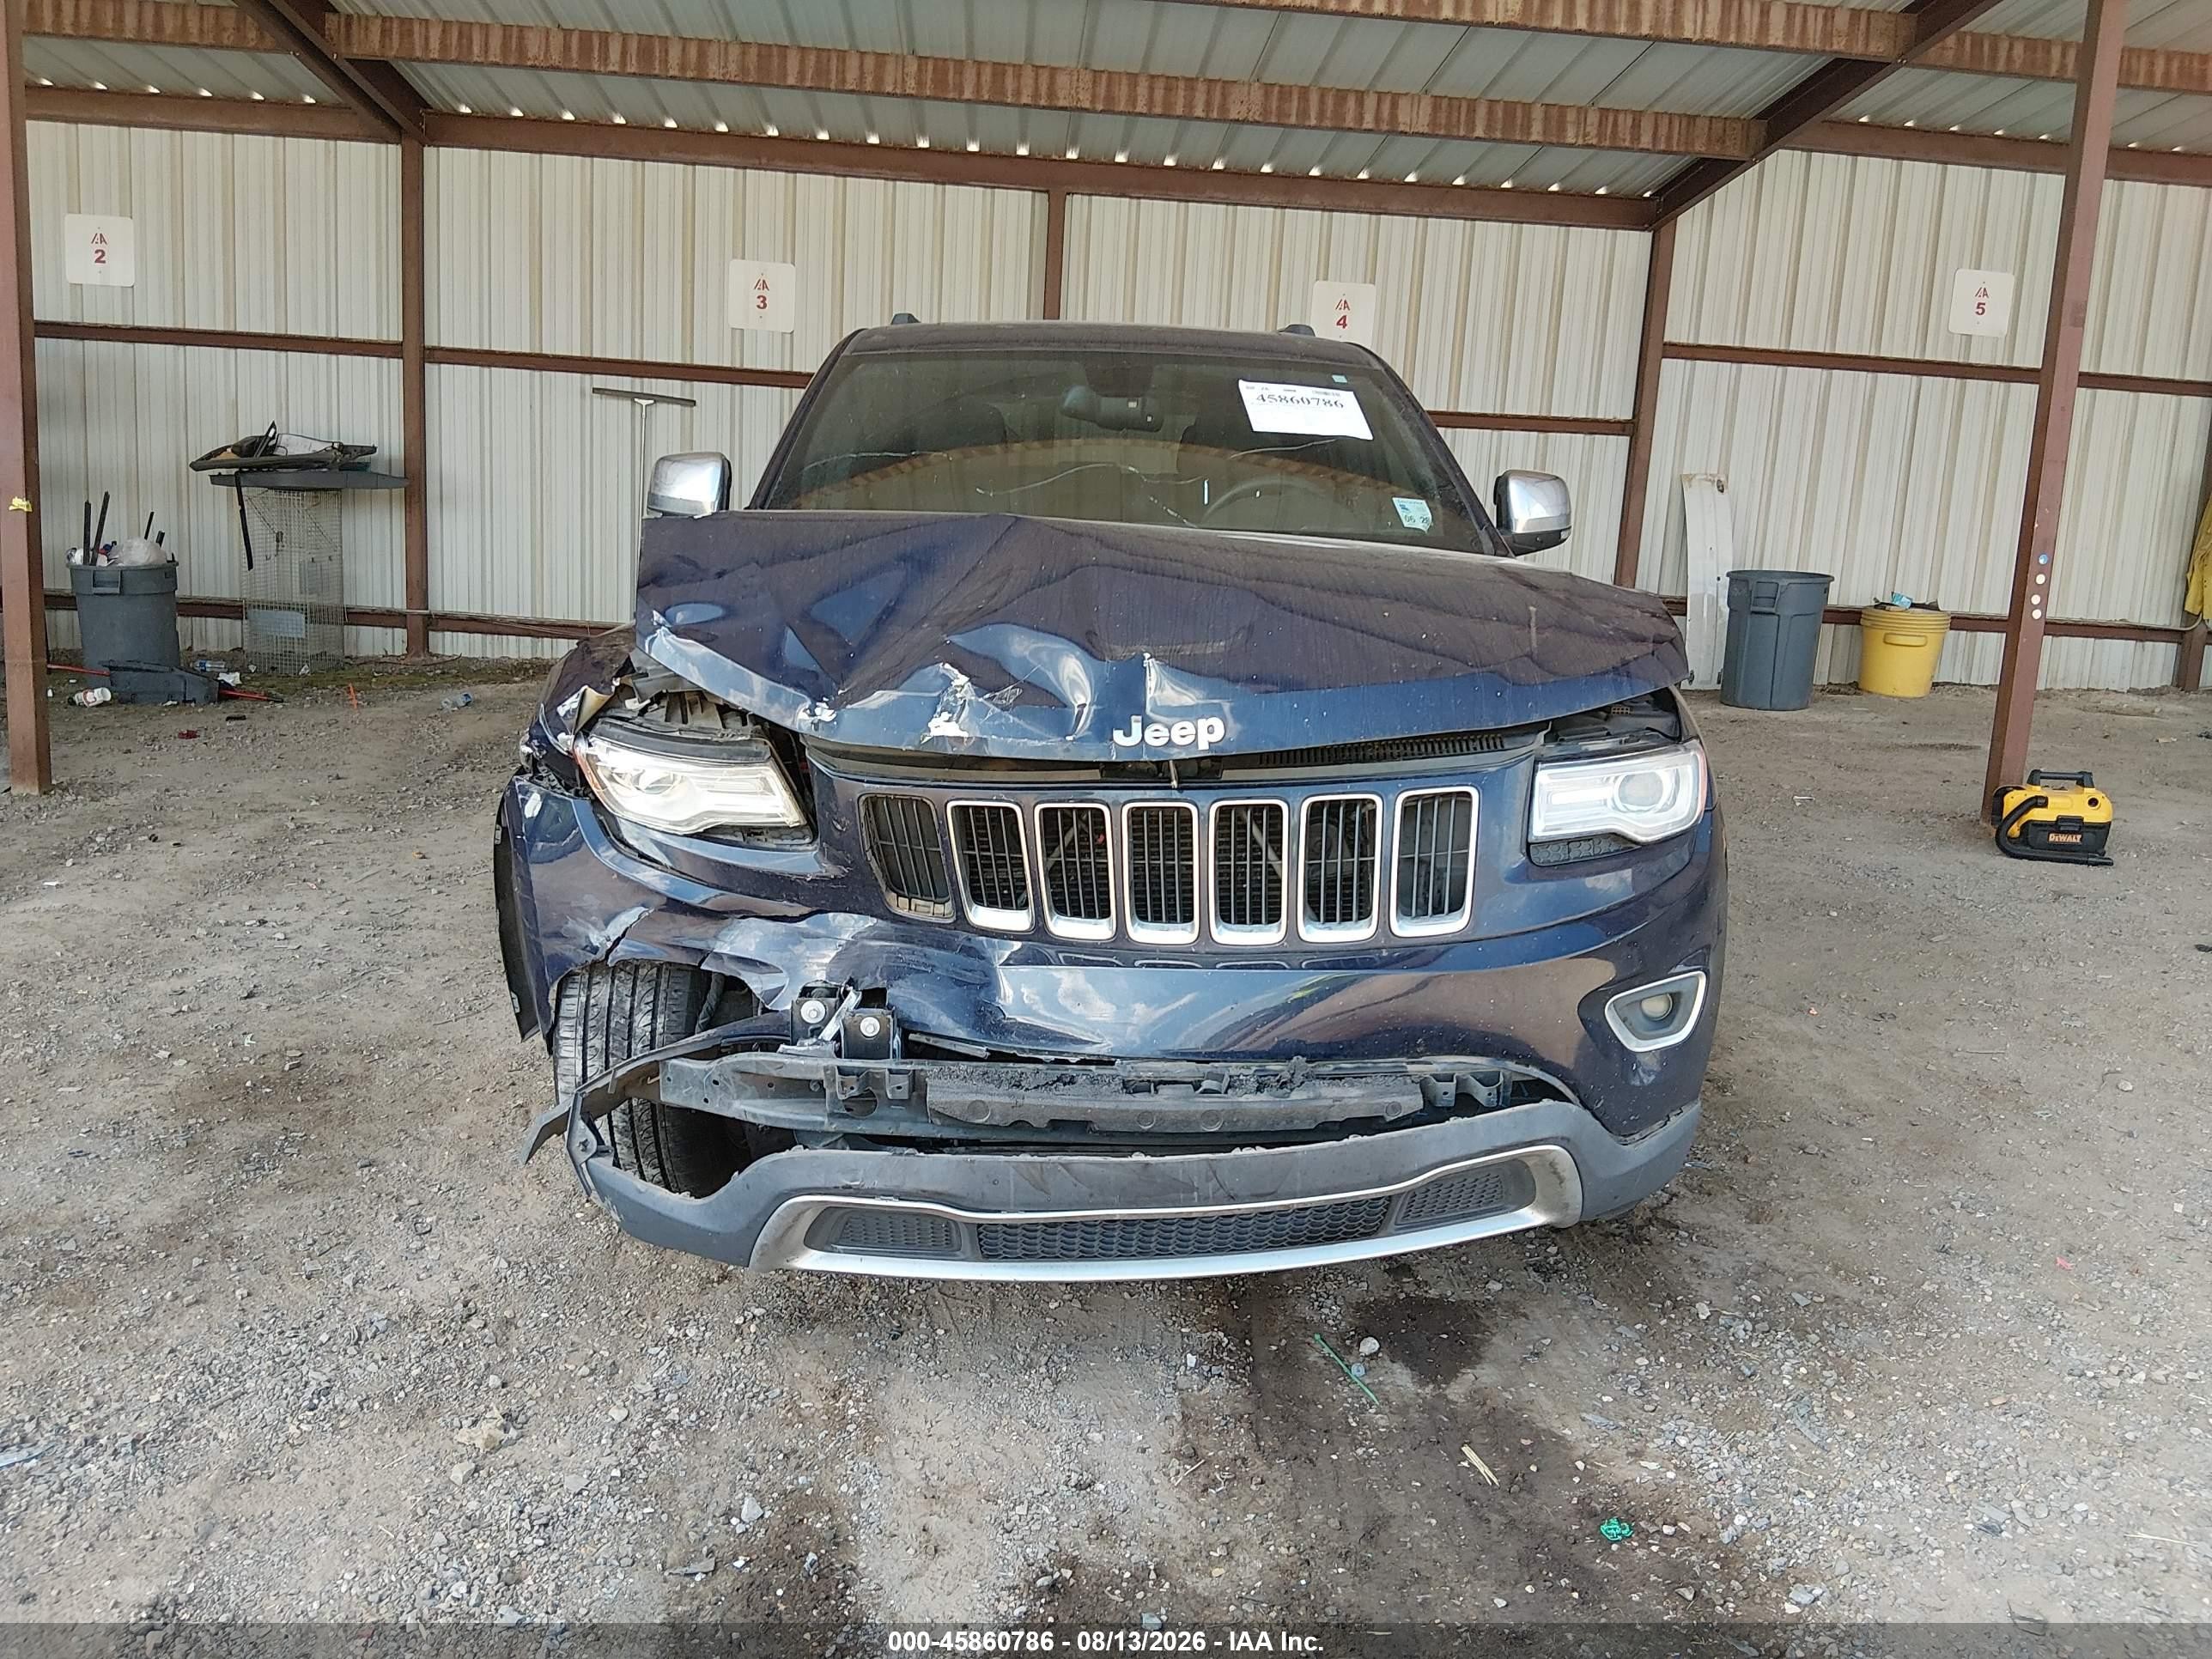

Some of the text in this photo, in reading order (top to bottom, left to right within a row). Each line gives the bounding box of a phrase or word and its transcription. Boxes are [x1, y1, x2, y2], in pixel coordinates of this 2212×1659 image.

[94, 249, 106, 264] 2
[757, 295, 768, 310] 3
[1975, 301, 1986, 316] 5
[1336, 314, 1347, 329] 4
[1256, 393, 1345, 409] 45860786
[1113, 714, 1225, 750] Jeep
